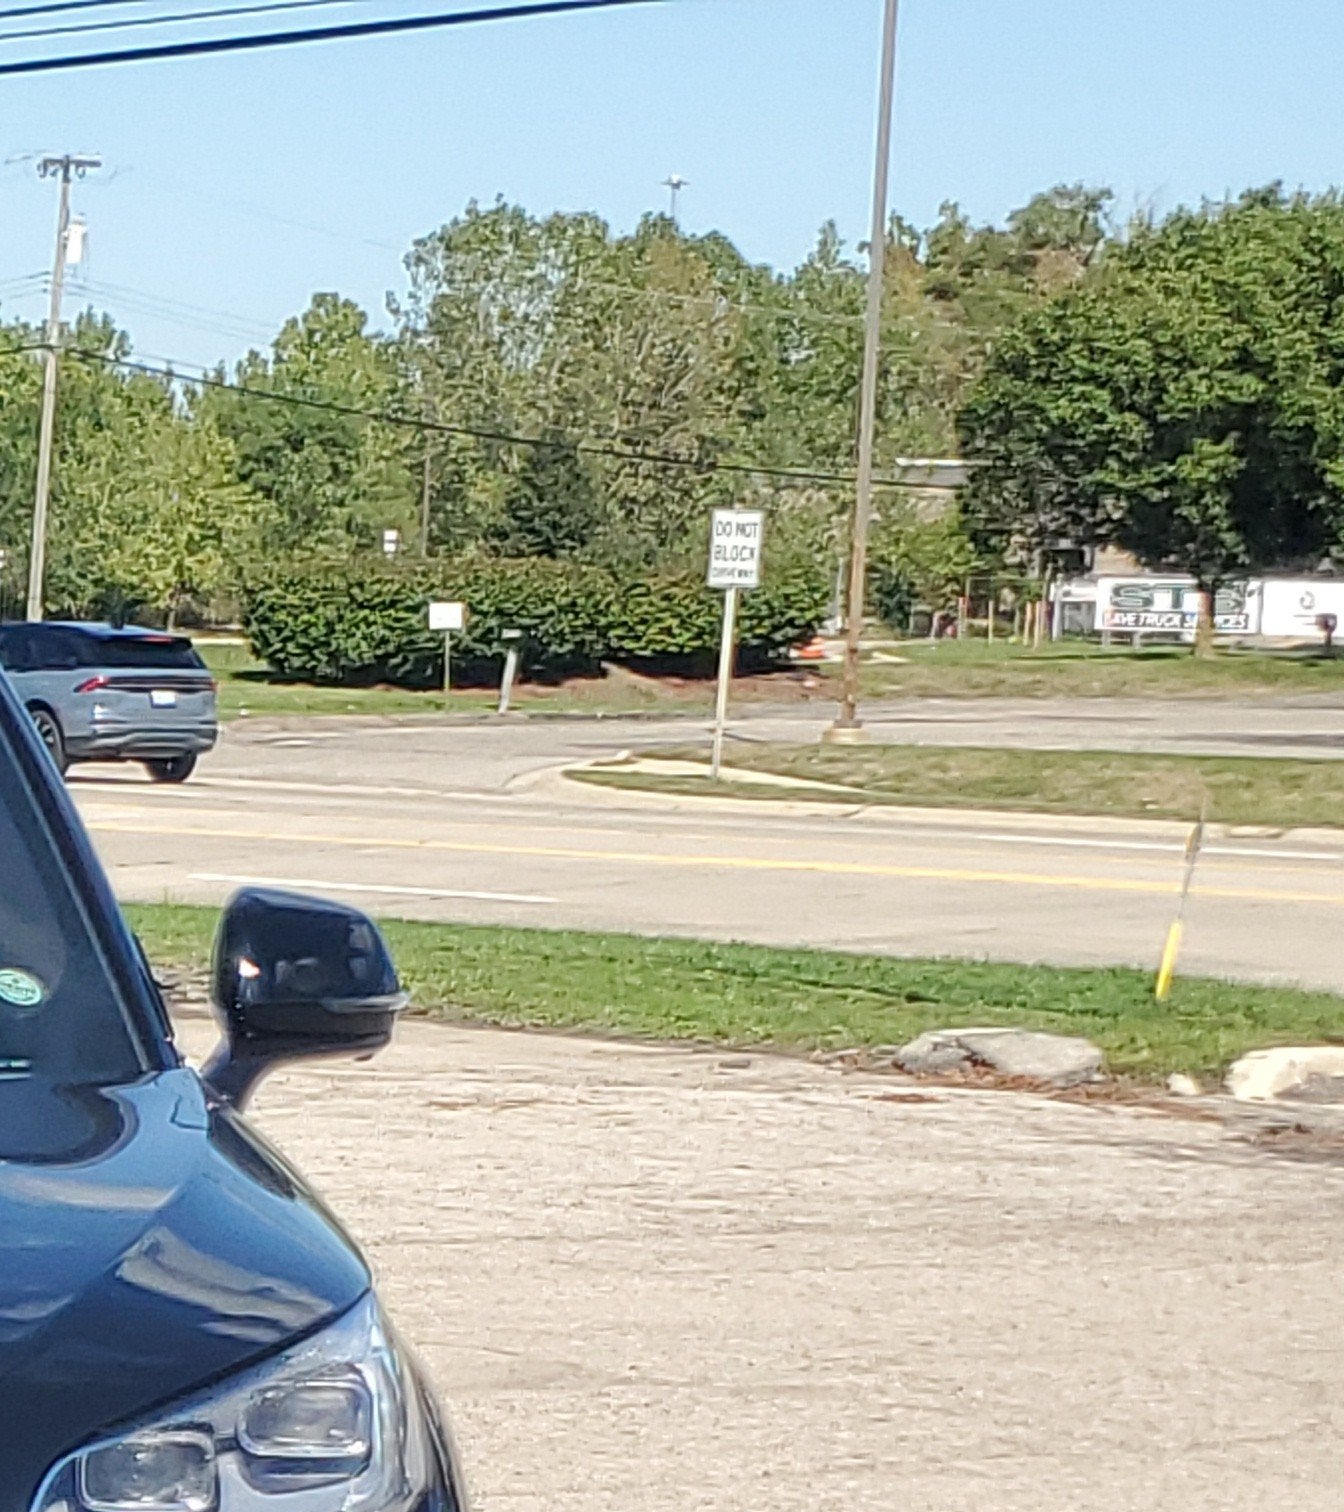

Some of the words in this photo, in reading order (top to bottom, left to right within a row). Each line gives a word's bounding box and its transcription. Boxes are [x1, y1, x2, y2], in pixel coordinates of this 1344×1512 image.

[715, 520, 733, 537] DO
[735, 521, 759, 538] NOT
[713, 544, 756, 562] BLOCK
